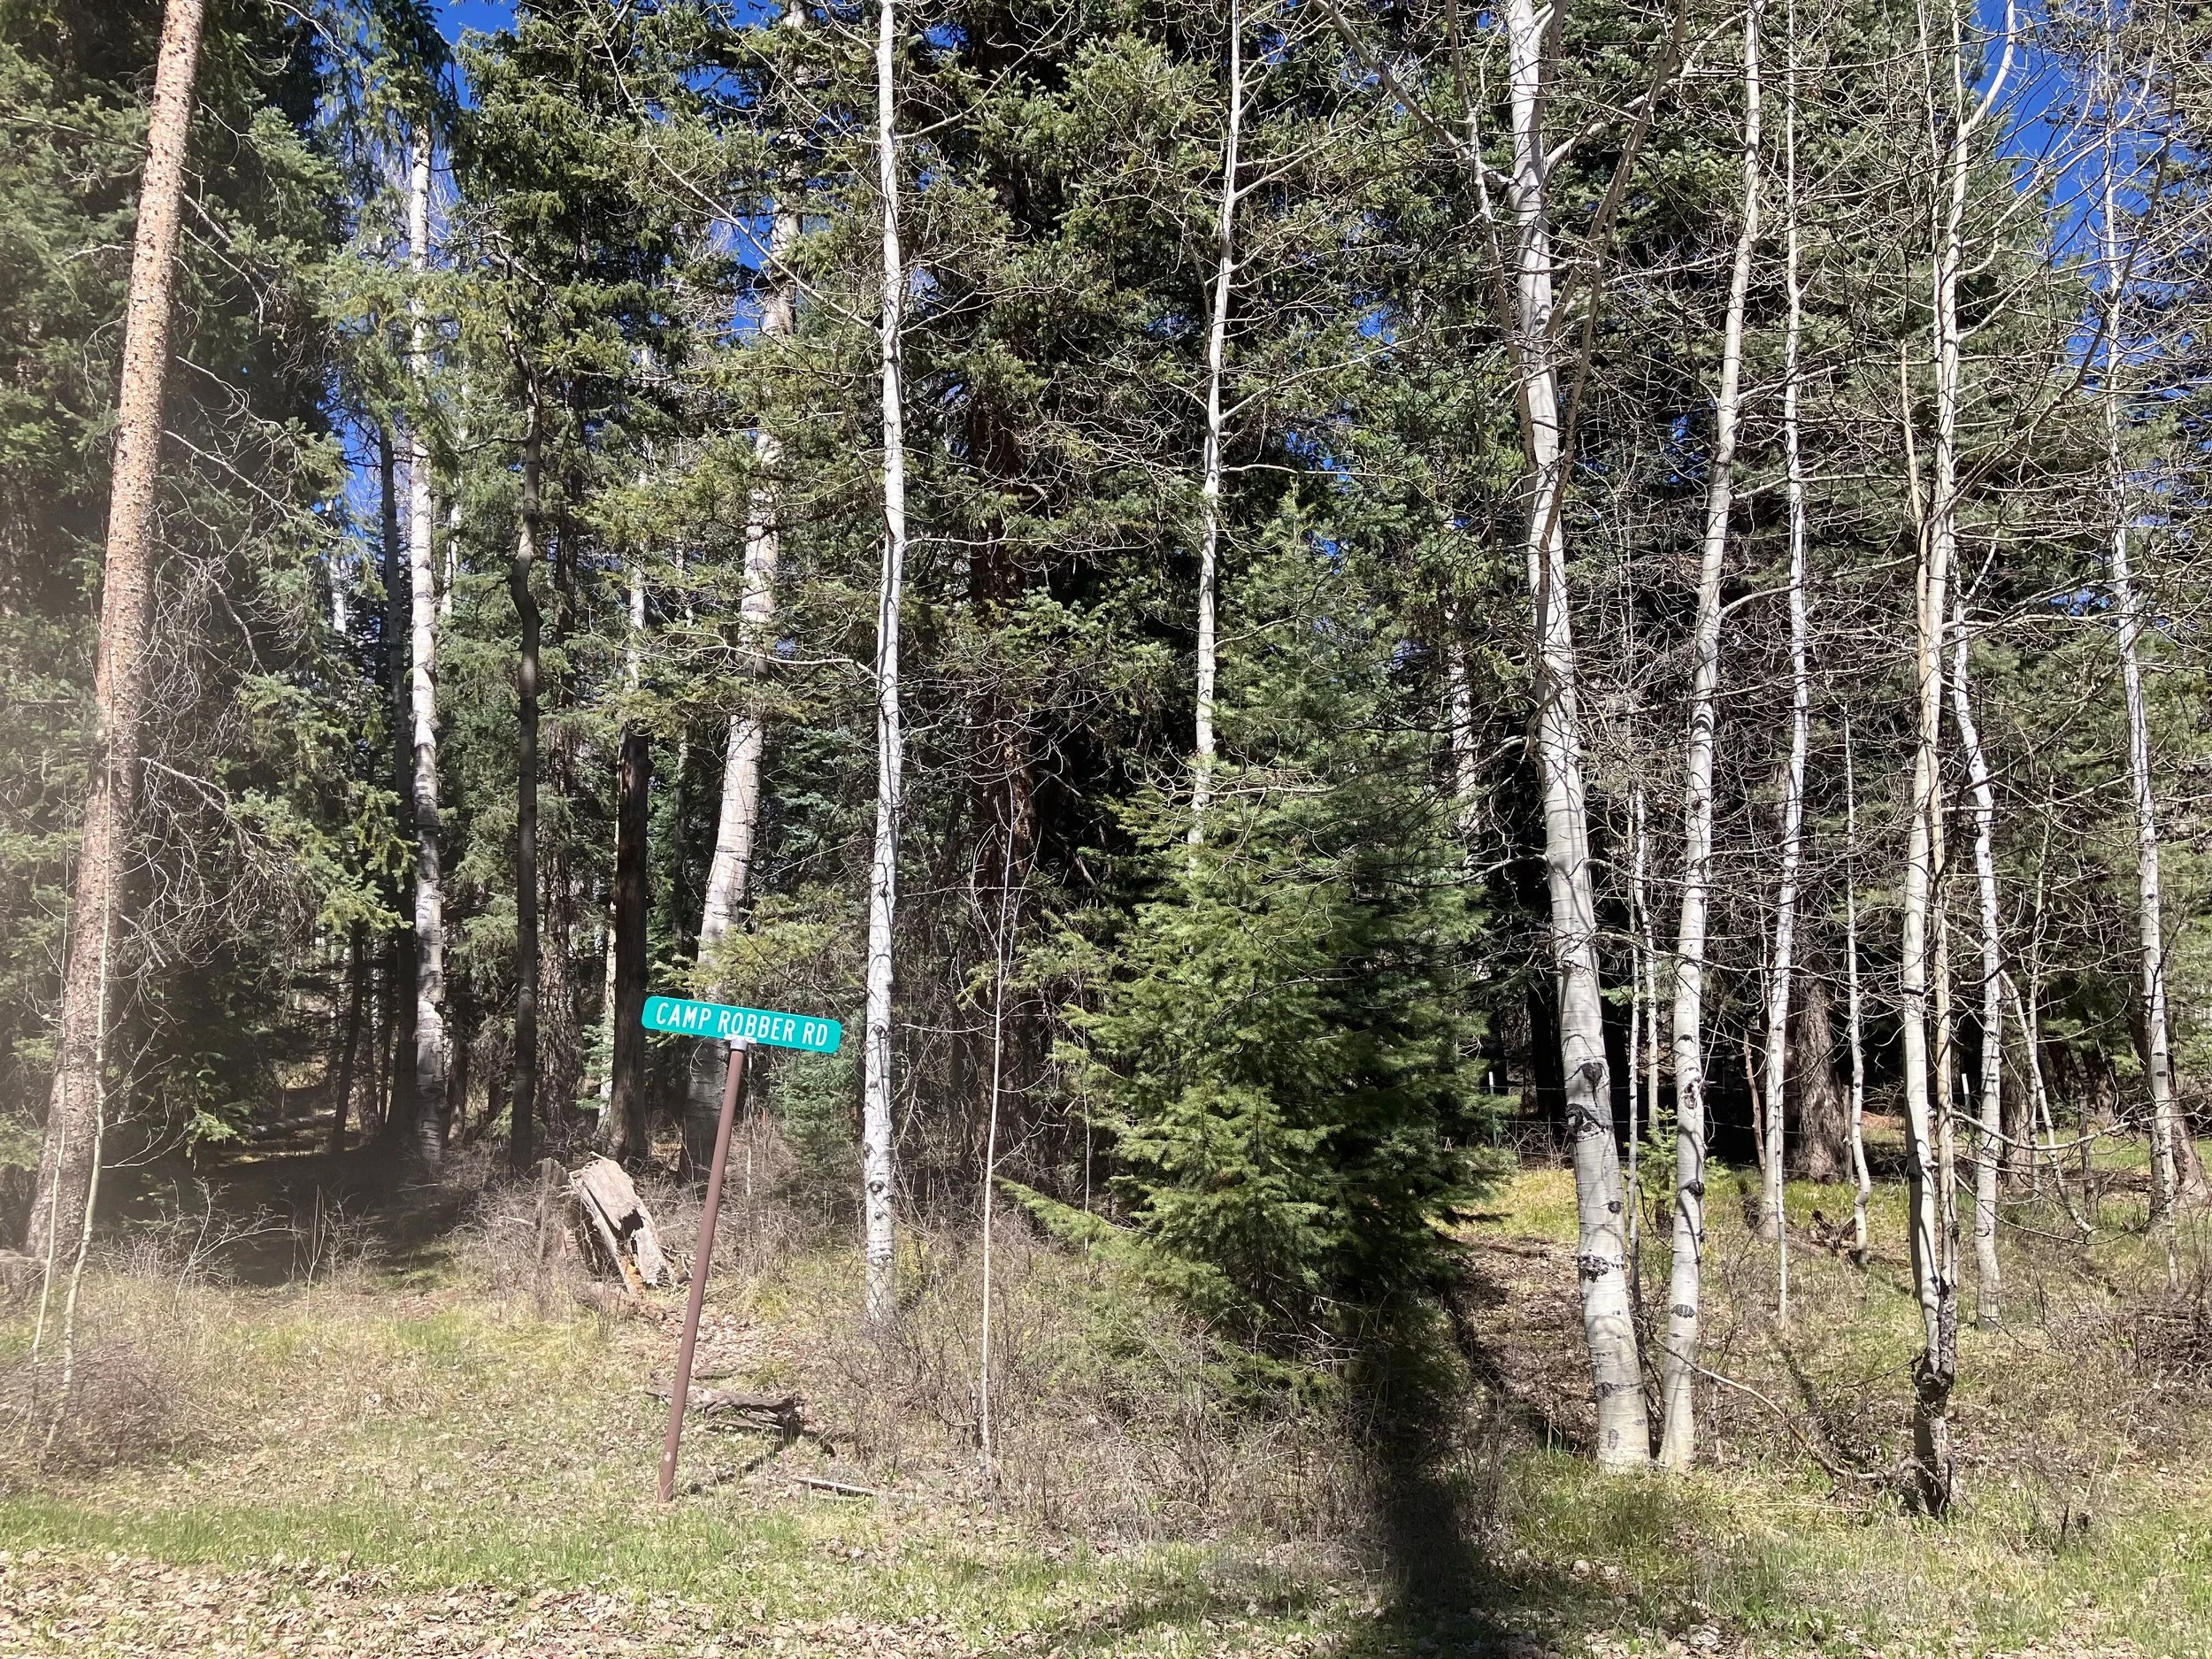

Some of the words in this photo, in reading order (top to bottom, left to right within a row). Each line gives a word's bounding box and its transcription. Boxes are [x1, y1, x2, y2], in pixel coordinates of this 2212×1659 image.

[656, 1002, 711, 1030] CAMP
[718, 1010, 795, 1042] ROBBER
[802, 1022, 828, 1047] RD
